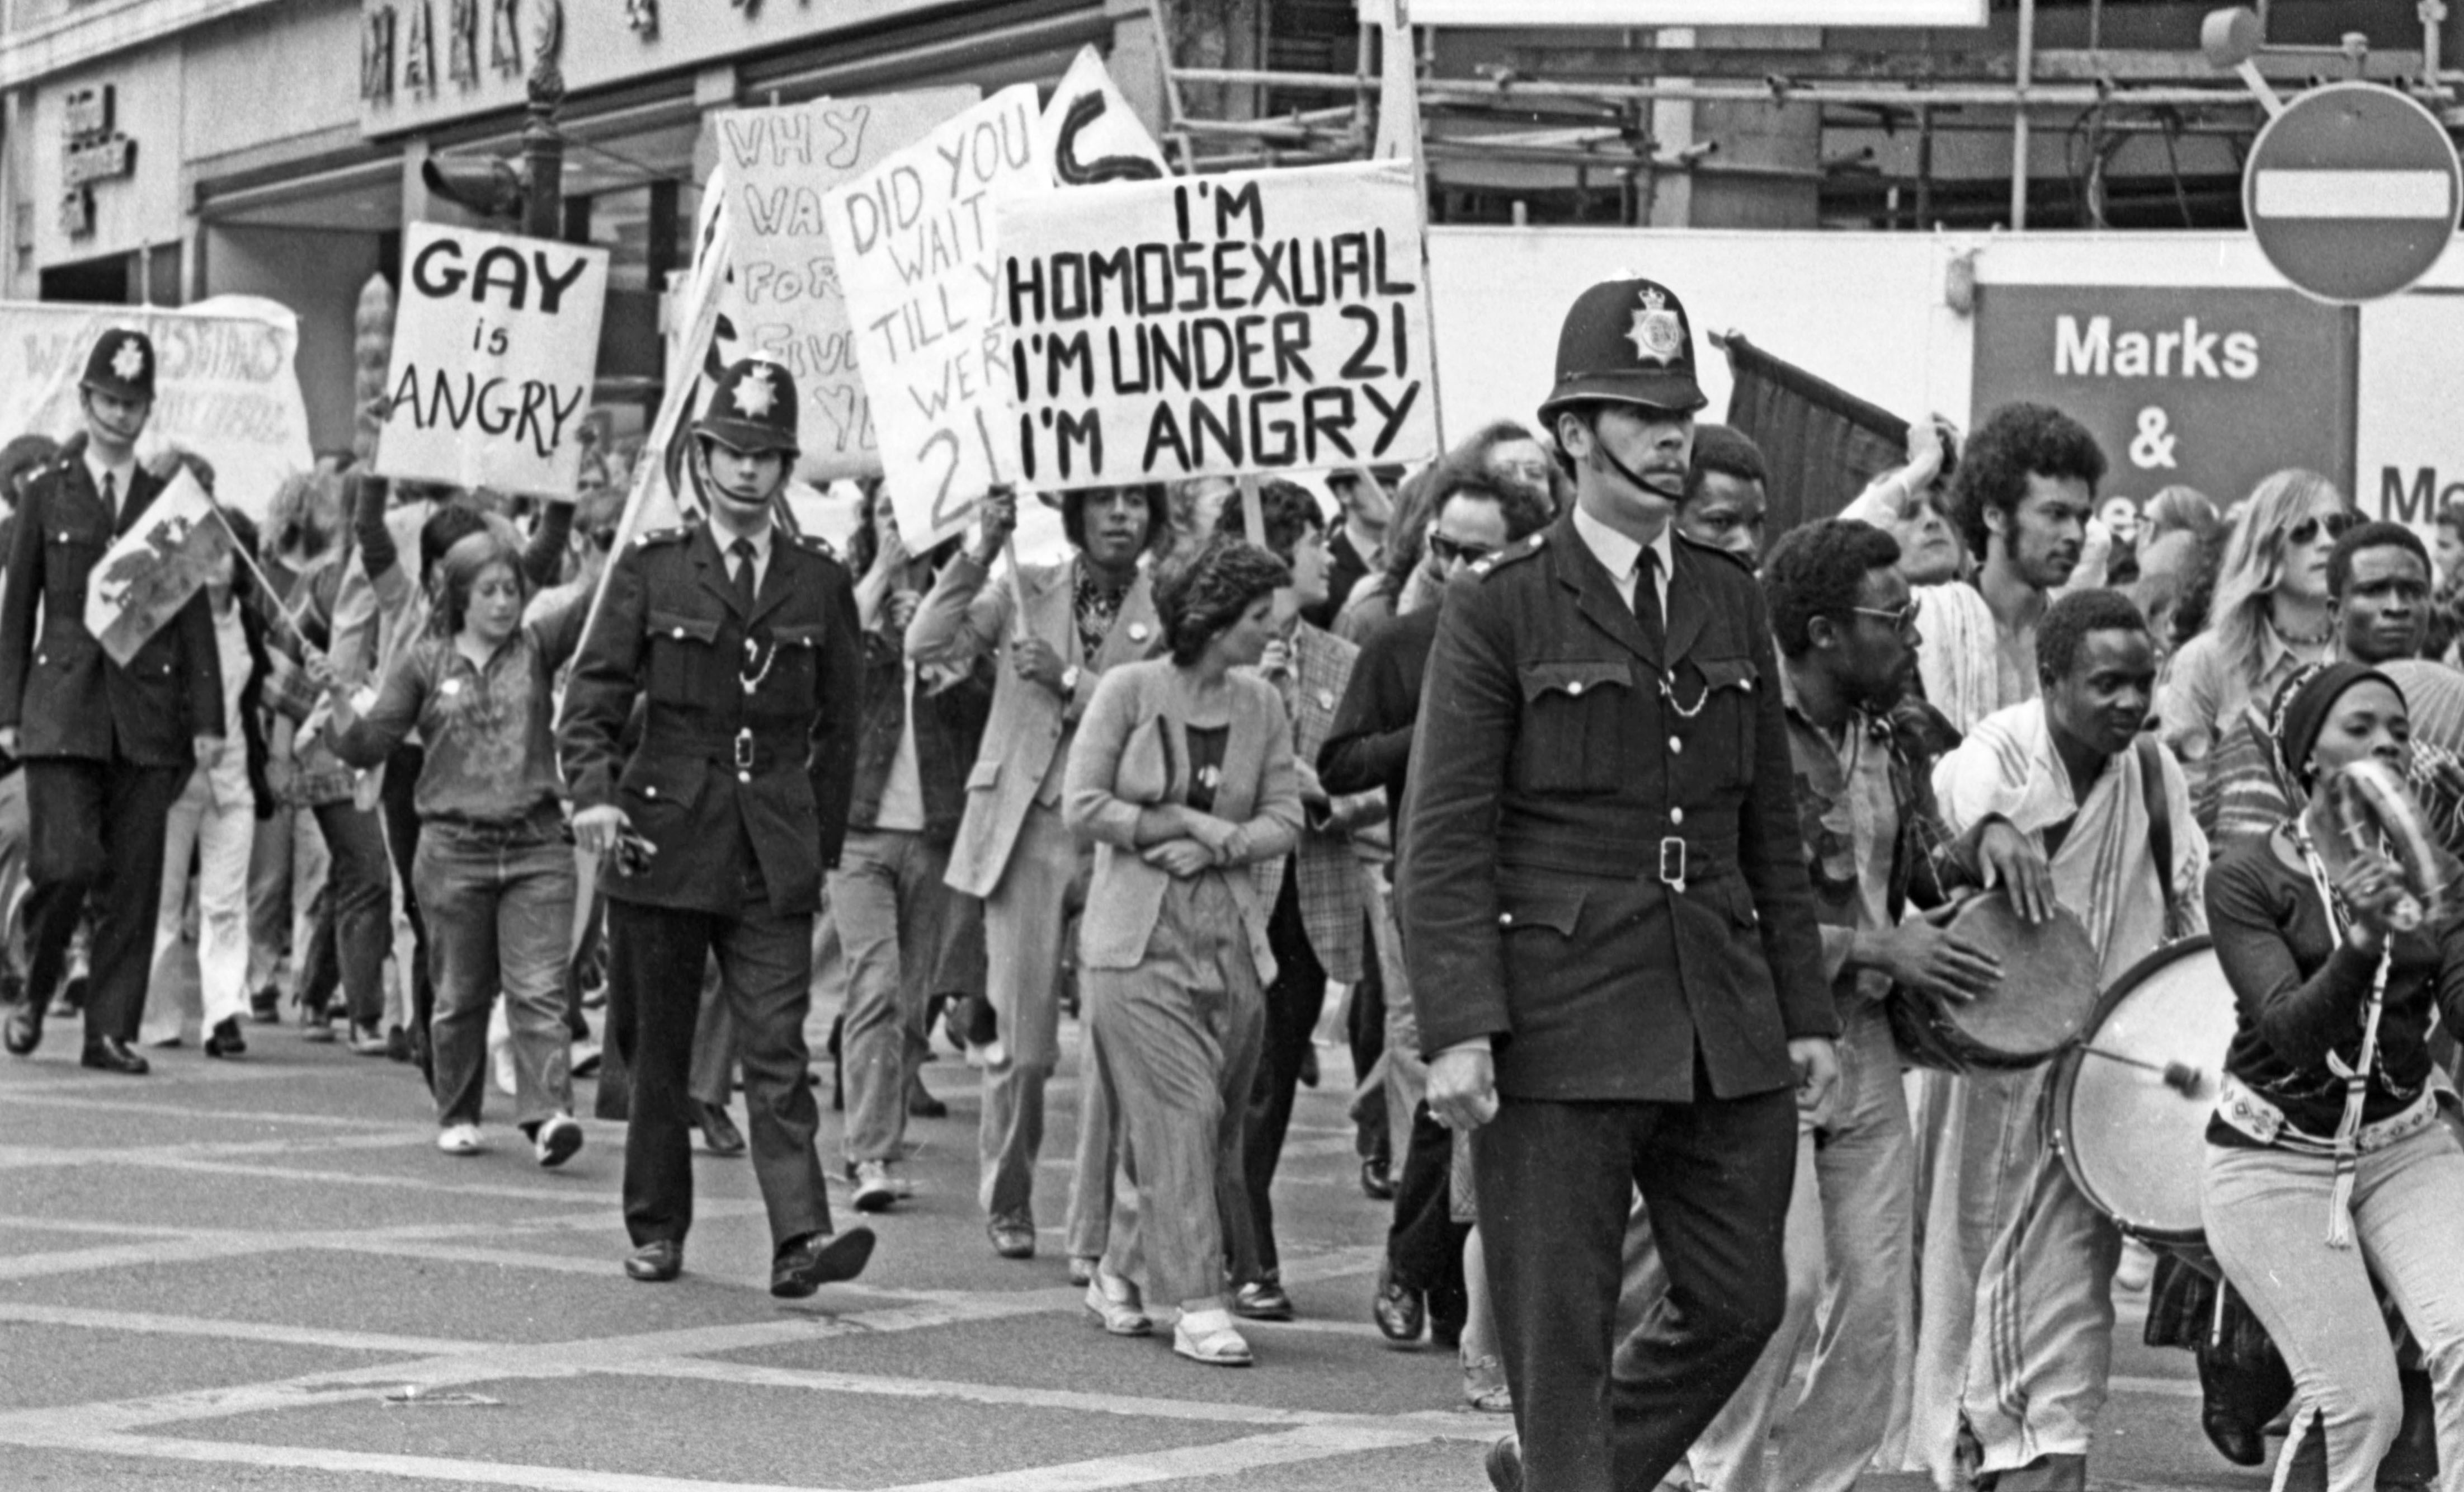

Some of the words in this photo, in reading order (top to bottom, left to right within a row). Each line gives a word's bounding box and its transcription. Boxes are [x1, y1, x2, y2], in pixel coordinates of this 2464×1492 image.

[724, 105, 870, 169] WHY
[745, 182, 824, 236] WA
[846, 165, 923, 255] DID
[938, 102, 1031, 199] YOU
[1175, 180, 1264, 241] I'M
[412, 239, 588, 314] GAY
[888, 191, 987, 286] WAIT
[1007, 227, 1416, 327] HOMOSEXUAL
[746, 256, 845, 305] FOR
[473, 317, 509, 356] is
[869, 282, 968, 364] TILL
[1013, 329, 1094, 402] I'M
[1109, 311, 1314, 395] UNDER
[1340, 301, 1407, 379] 21
[2054, 314, 2258, 379] Marks
[389, 363, 584, 458] ANGRY
[908, 320, 1010, 421] WER
[917, 407, 1002, 530] 21
[1020, 406, 1103, 480] I'M
[1142, 380, 1421, 472] ANGRY
[2128, 406, 2178, 470] &
